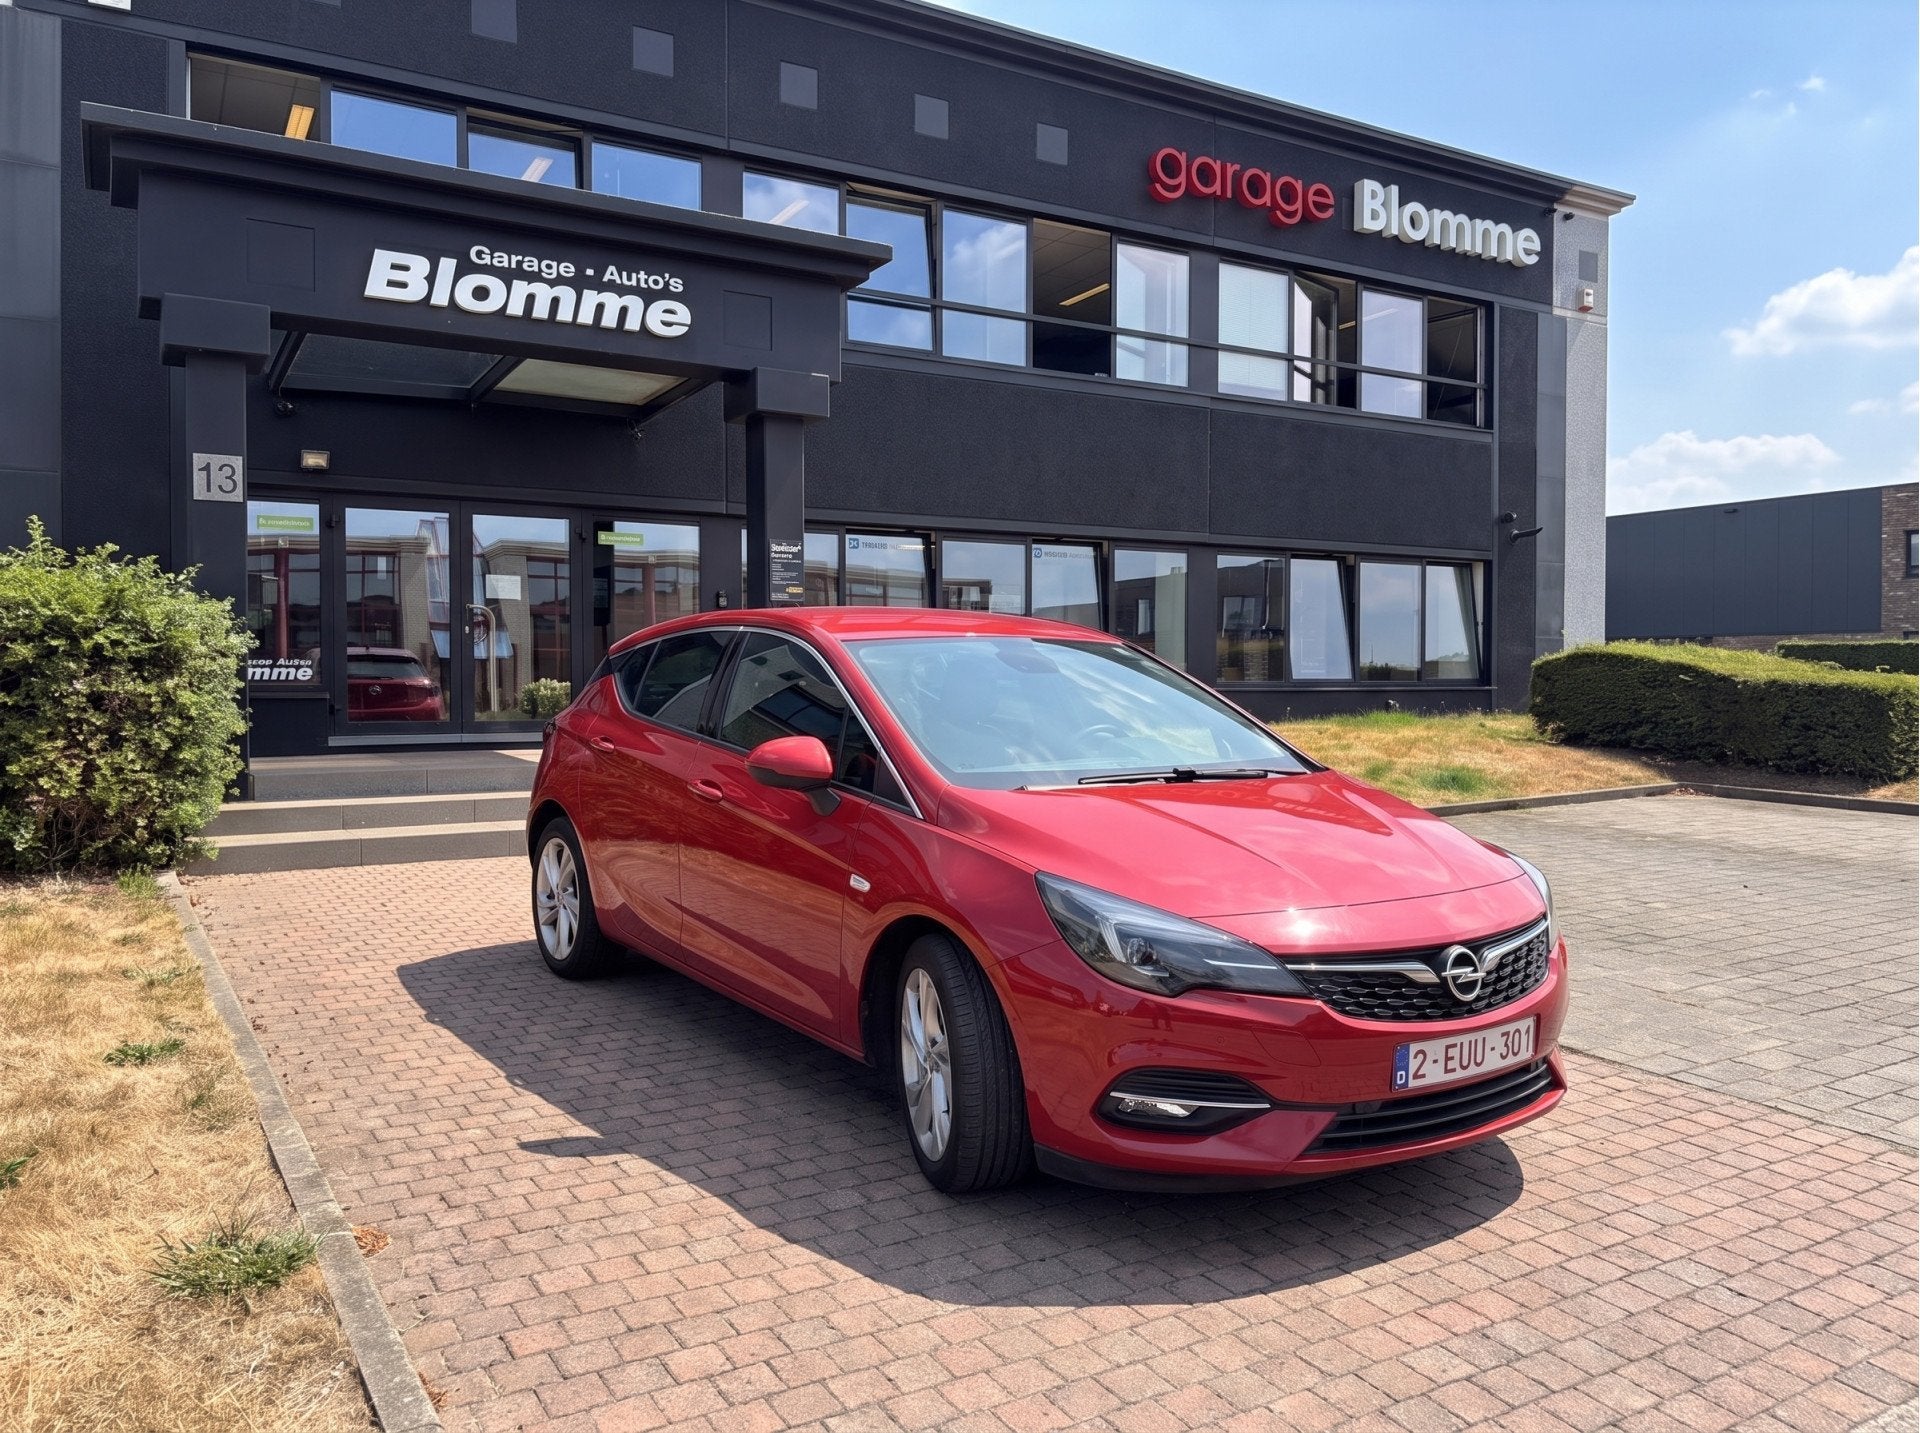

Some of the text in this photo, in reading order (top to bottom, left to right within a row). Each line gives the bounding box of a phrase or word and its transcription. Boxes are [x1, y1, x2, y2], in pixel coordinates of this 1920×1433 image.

[1148, 147, 1541, 267] garage Blomme
[364, 248, 692, 338] Blomme
[469, 245, 684, 293] Garage Auto's
[198, 461, 238, 494] 13
